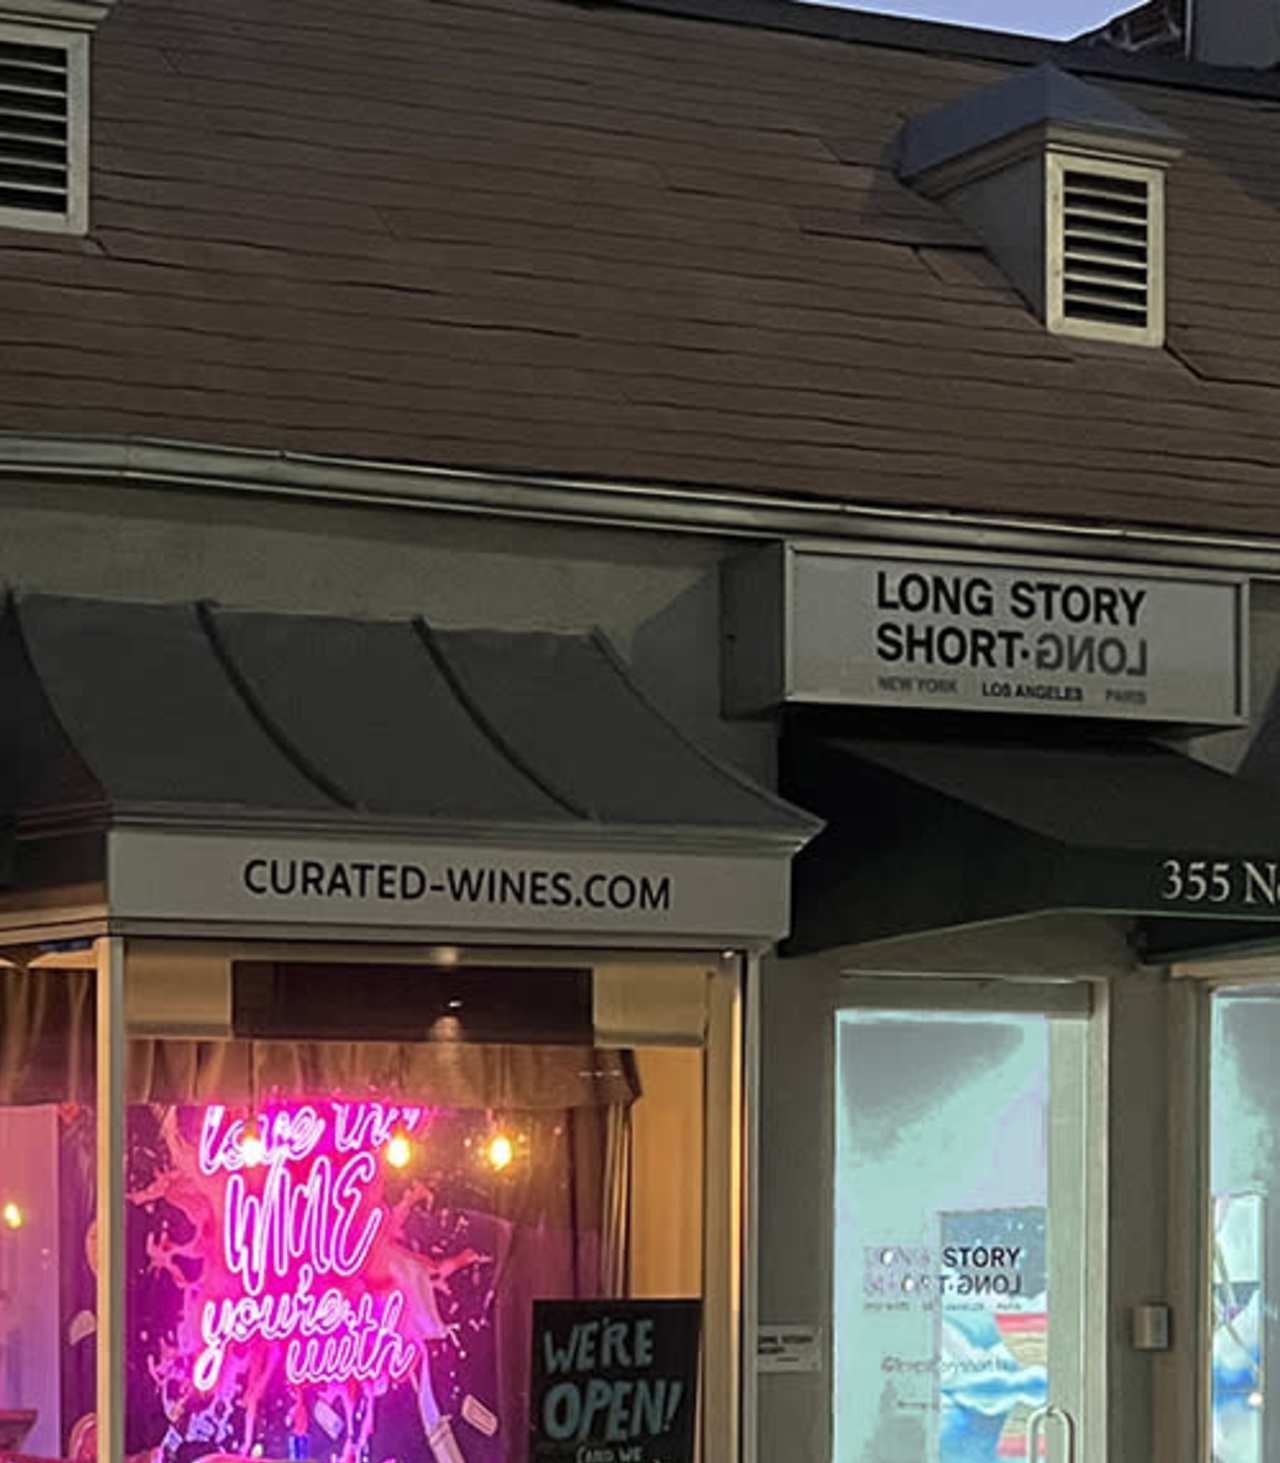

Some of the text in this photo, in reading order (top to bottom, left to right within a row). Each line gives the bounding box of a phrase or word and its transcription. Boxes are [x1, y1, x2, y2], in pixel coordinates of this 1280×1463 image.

[877, 570, 1147, 627] LONG STORY
[877, 675, 959, 694] NEW YORK
[981, 681, 1083, 702] LOS ANGELES
[243, 858, 671, 911] CURATED-WINES.COM
[1161, 859, 1280, 904] 355 N
[225, 1151, 382, 1296] WINE
[942, 1246, 1022, 1269] STORY
[286, 1289, 416, 1385] with
[543, 1316, 655, 1375] WE'RE
[543, 1378, 685, 1444] OPEN!
